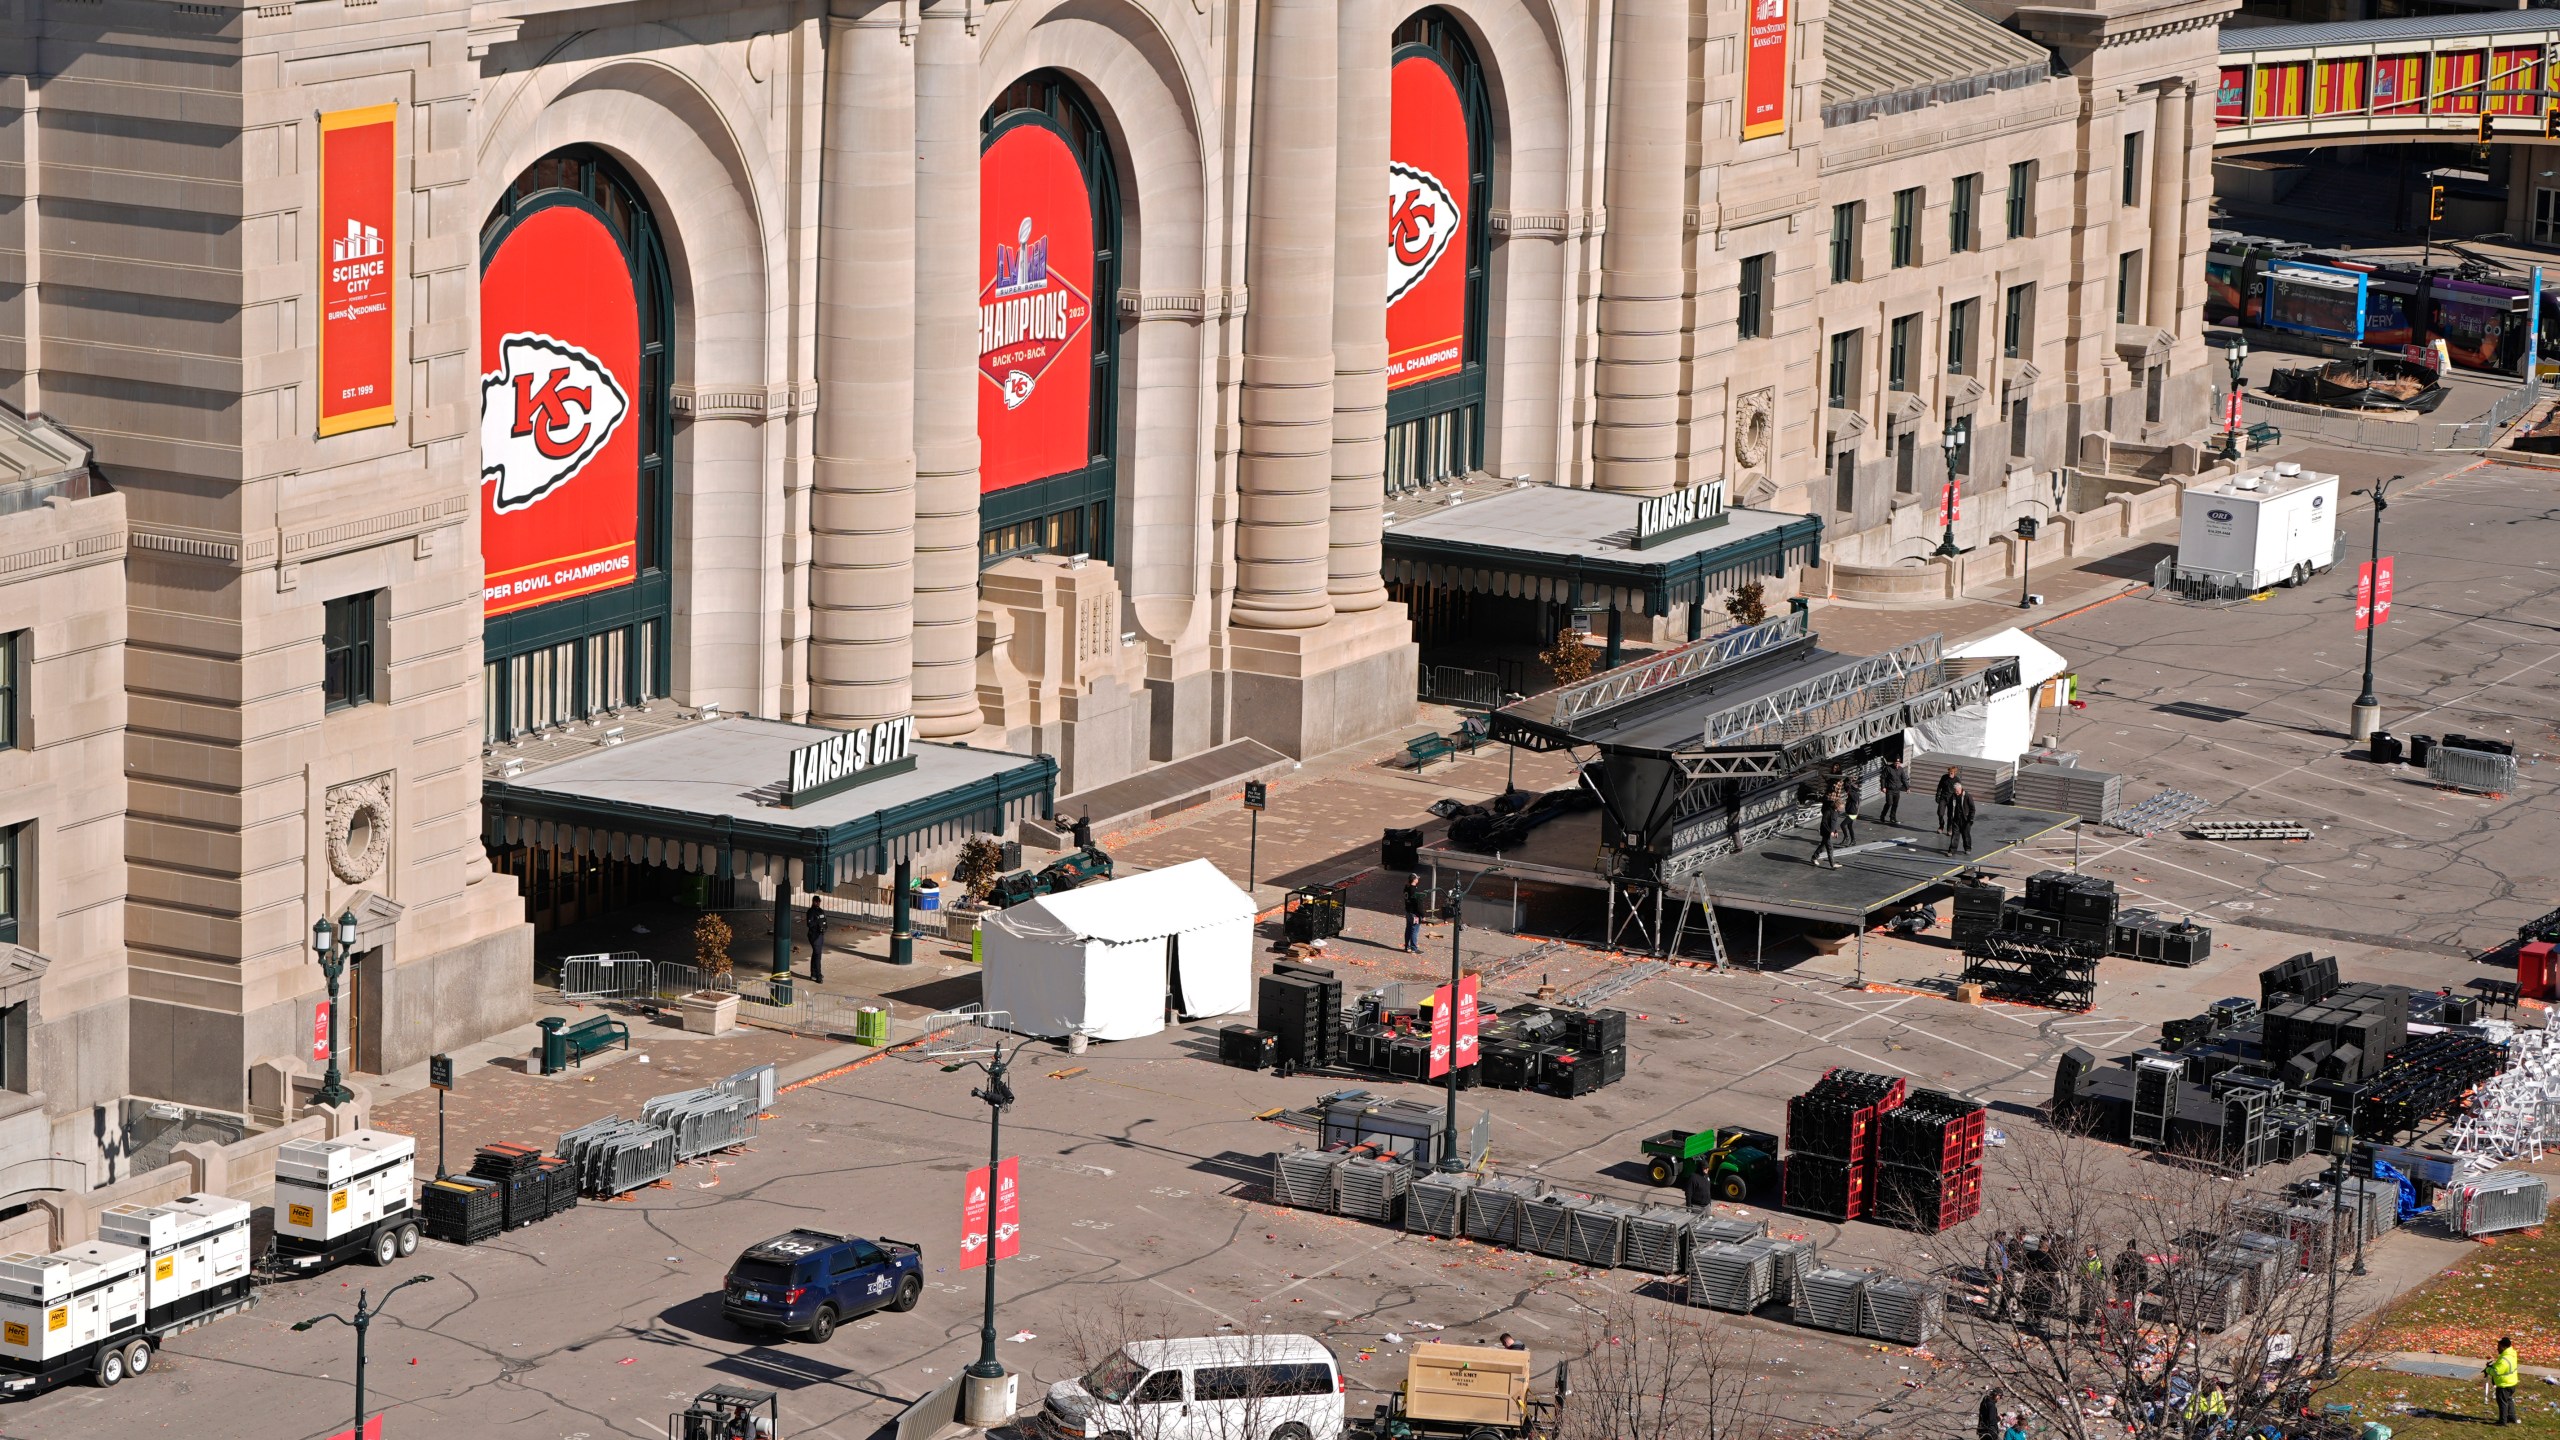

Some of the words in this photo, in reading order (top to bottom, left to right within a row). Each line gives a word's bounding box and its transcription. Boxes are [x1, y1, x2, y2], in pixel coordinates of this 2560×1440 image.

[1767, 23, 1786, 34] STATION
[1754, 37, 1771, 48] KANSAS
[1771, 35, 1782, 45] CITY
[2253, 58, 2360, 117] BACK
[333, 260, 384, 282] SCIENCE
[347, 278, 371, 293] CITY
[1000, 284, 1022, 296] SUPER
[1024, 282, 1043, 292] BOWL
[328, 310, 348, 320] BURNS
[1069, 306, 1085, 319] 2023
[1387, 361, 1400, 377] OWL
[1406, 347, 1458, 371] CHAMPIONS
[342, 388, 356, 399] EST.
[357, 384, 374, 396] 1999
[1011, 377, 1028, 398] KC
[510, 367, 592, 460] KC
[1641, 488, 1695, 537] KANSAS
[1697, 478, 1726, 519] CITY
[2211, 512, 2229, 520] ORI
[482, 583, 511, 601] PER
[514, 574, 551, 595] BOWL
[554, 555, 630, 585] CHAMPIONS
[793, 728, 868, 793] KANSAS
[873, 715, 915, 765] CITY
[293, 1208, 310, 1218] Herc
[768, 1241, 815, 1256] 132
[157, 1264, 171, 1273] Herc
[726, 1296, 741, 1305] POLICE
[51, 1311, 65, 1321] Herc
[8, 1326, 26, 1336] Herc
